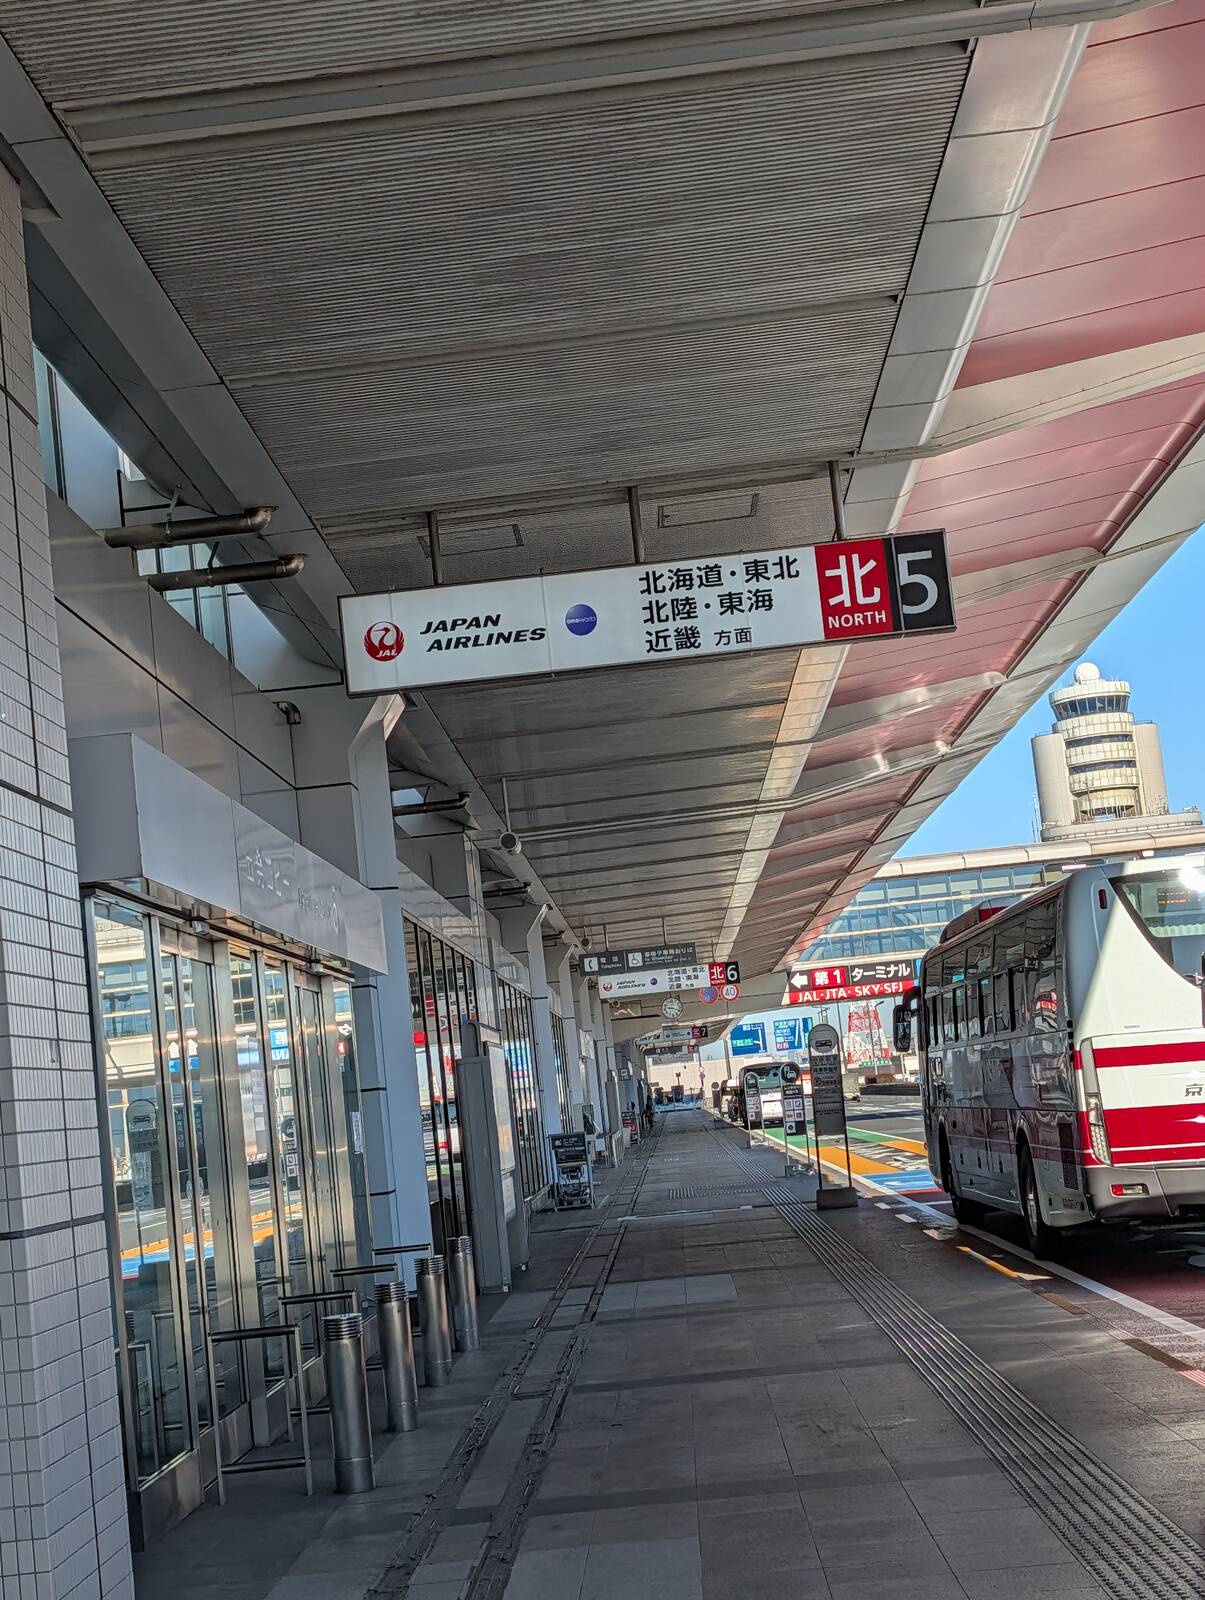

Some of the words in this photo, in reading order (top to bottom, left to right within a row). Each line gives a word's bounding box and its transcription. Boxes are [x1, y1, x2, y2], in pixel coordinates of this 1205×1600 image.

[825, 552, 881, 608] 北
[896, 550, 938, 614] 5
[419, 614, 502, 635] JAPAN
[828, 609, 886, 629] NORTH
[426, 628, 547, 652] AIRLINES
[645, 626, 702, 654] 近畿
[713, 628, 752, 647] 方面
[376, 648, 398, 658] JAL
[711, 965, 724, 979] 北
[727, 965, 738, 981] 6
[851, 963, 911, 982] ターミナル
[725, 986, 736, 996] 40
